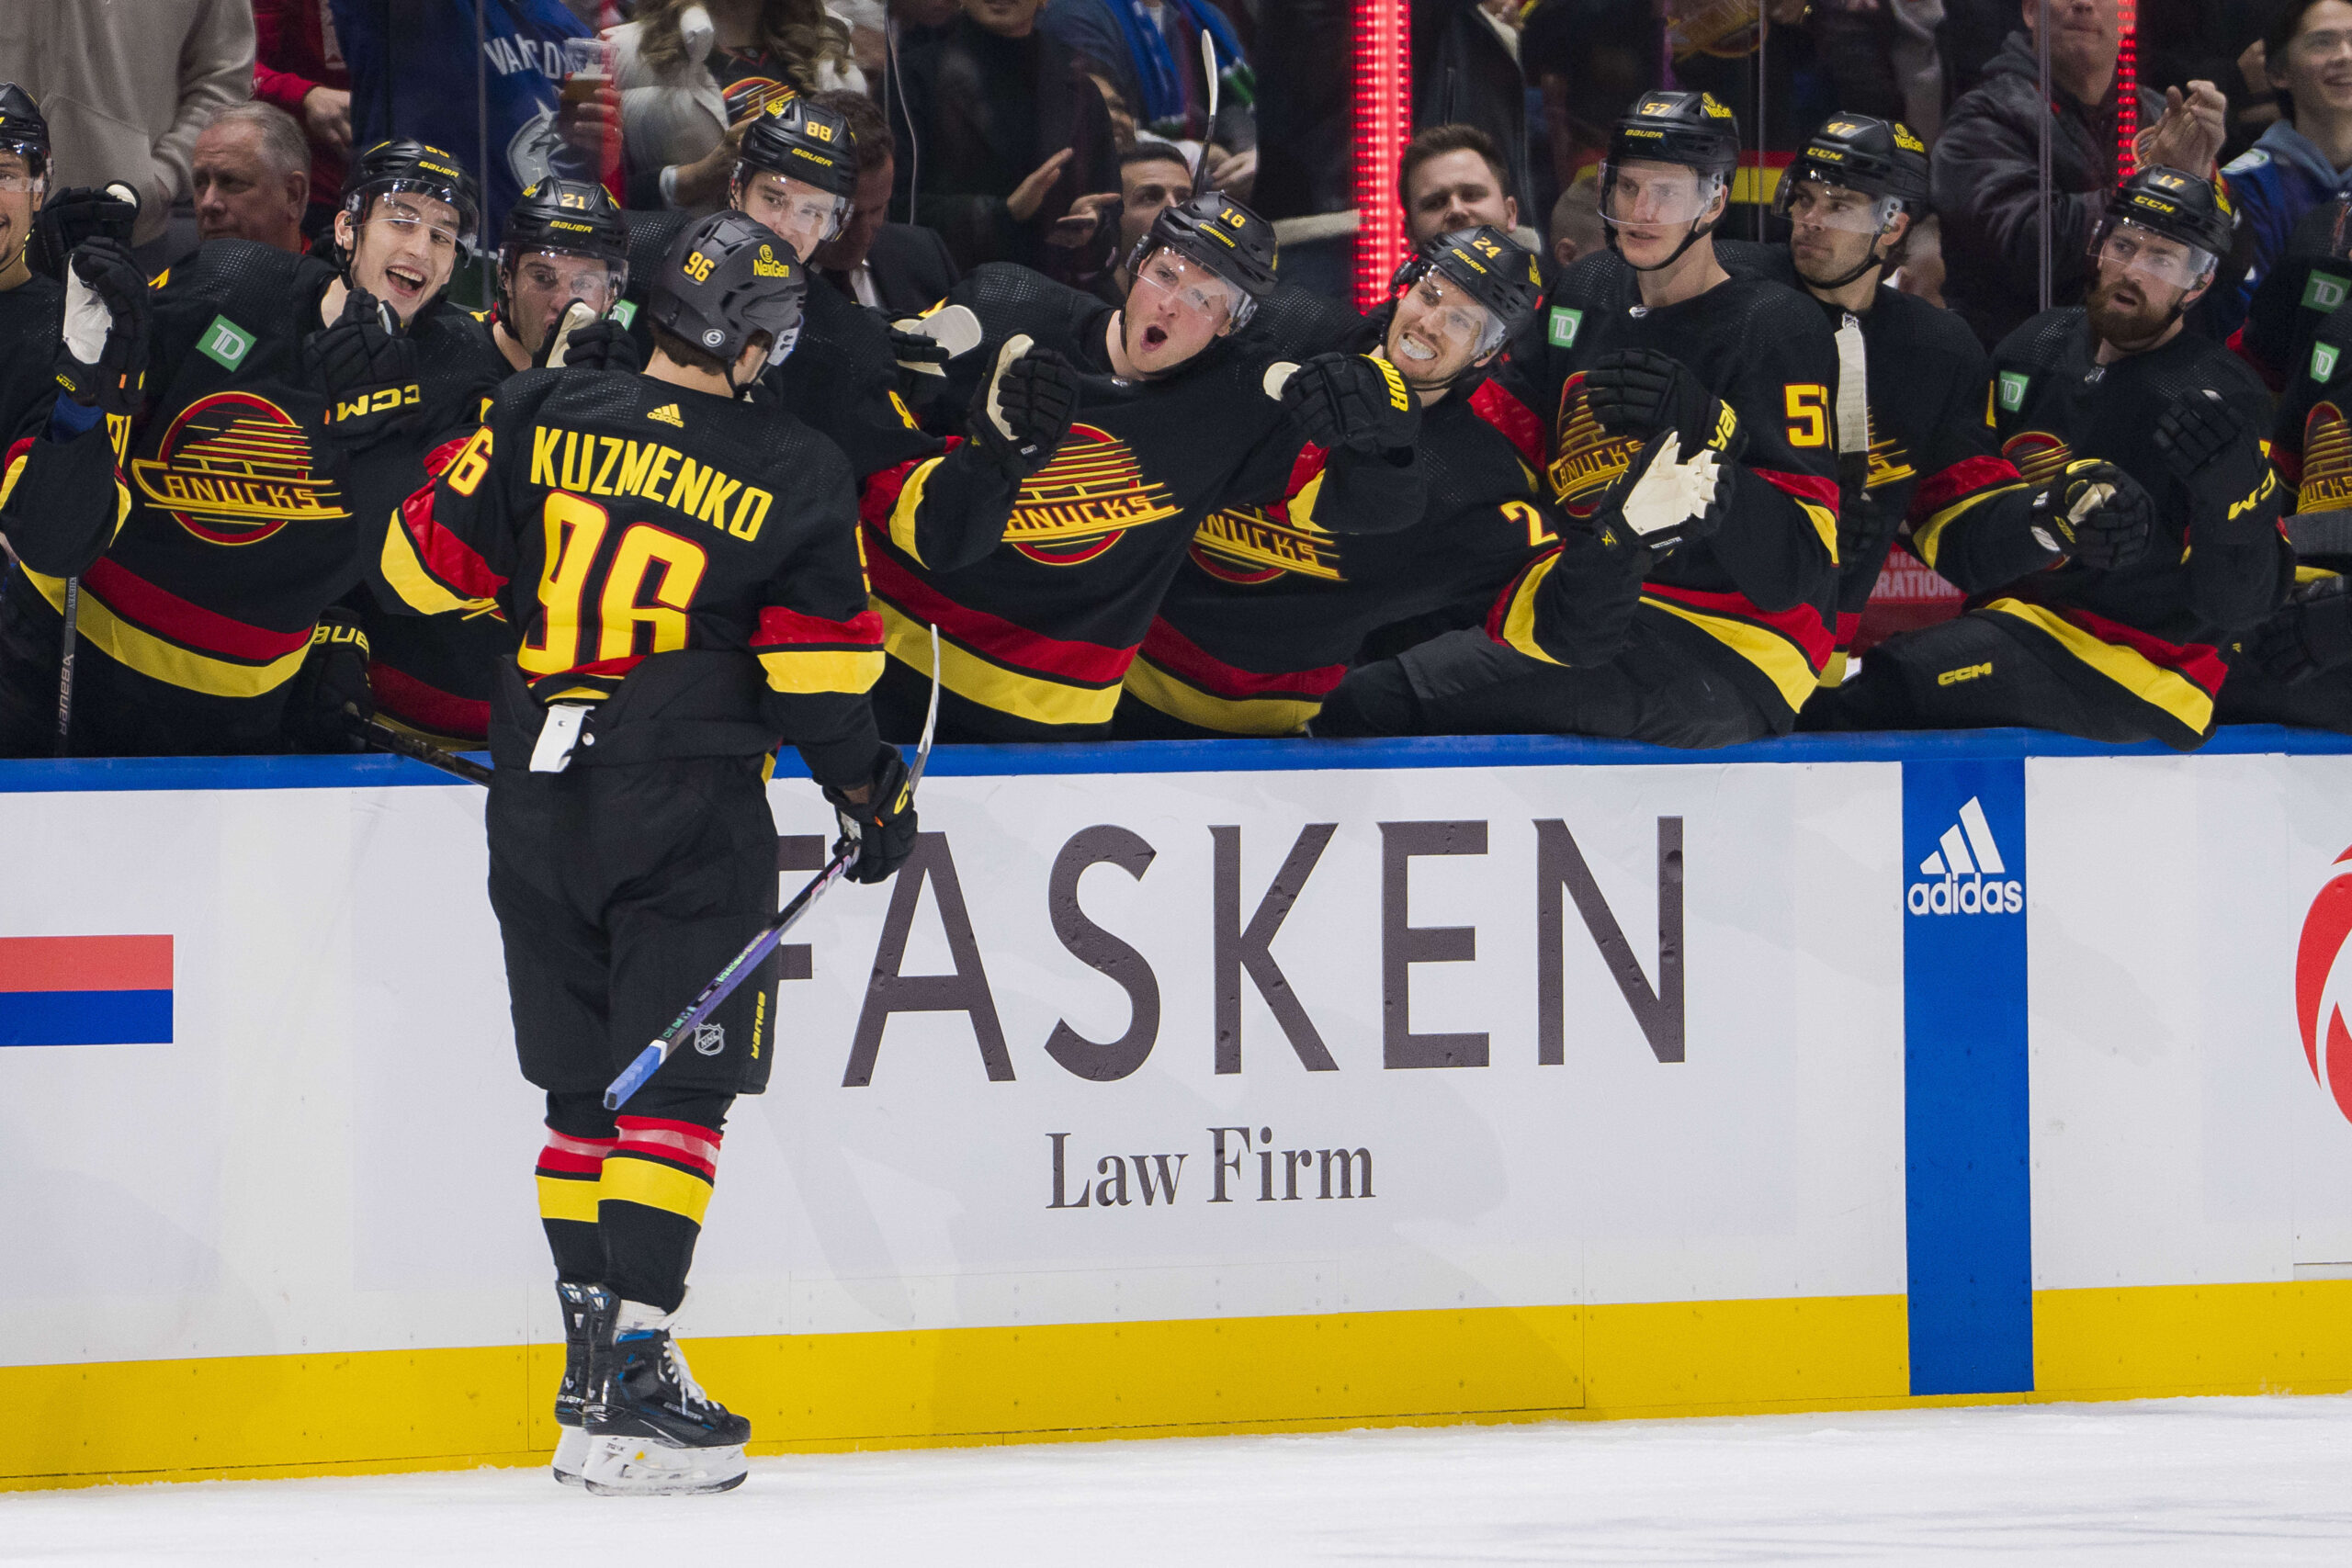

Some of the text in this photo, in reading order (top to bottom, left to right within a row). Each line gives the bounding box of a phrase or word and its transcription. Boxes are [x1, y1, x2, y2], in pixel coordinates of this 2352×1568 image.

[1641, 102, 1671, 118] 57
[806, 120, 832, 142] 88
[1624, 129, 1664, 139] BAUER
[791, 147, 833, 167] BAUER
[1806, 147, 1843, 161] CCM
[418, 161, 459, 178] BAUER
[560, 193, 586, 210] 21
[2133, 195, 2176, 214] CCM
[549, 220, 593, 233] BAUER
[1219, 208, 1246, 229] 16
[1472, 236, 1502, 260] 24
[683, 251, 716, 282] 96
[752, 259, 790, 277] NexGen
[1452, 248, 1487, 275] BAUER
[2313, 278, 2344, 307] TD
[1553, 313, 1577, 340] TD
[209, 323, 246, 361] TD
[2314, 349, 2334, 376] TD
[336, 383, 421, 423] CCM
[2001, 378, 2022, 404] TD
[131, 458, 353, 521] CANUCKS
[530, 425, 774, 543] KUZMENKO
[516, 488, 708, 675] 96
[1938, 661, 1993, 686] CCM
[58, 669, 71, 736] BAUER
[1907, 872, 2023, 915] adidas
[751, 991, 766, 1060] BAUER
[1045, 1125, 1377, 1210] Law Firm
